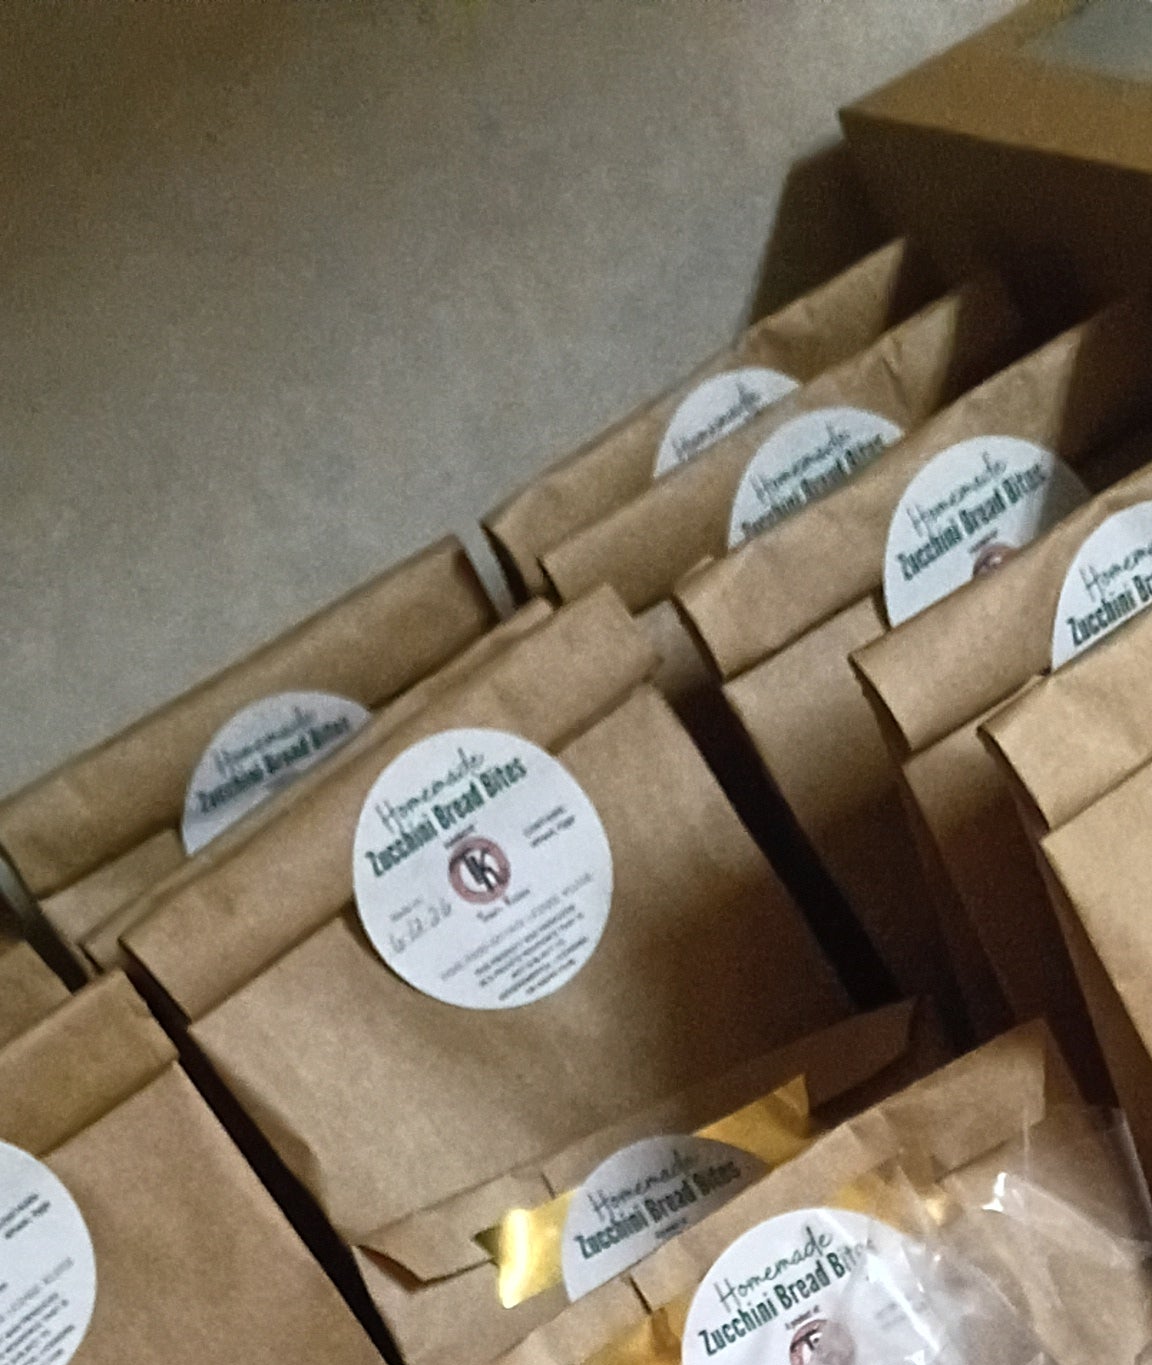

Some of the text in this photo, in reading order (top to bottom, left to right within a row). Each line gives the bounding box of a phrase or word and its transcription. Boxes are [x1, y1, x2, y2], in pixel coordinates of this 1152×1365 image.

[698, 1292, 778, 1358] Zucchini
[773, 1259, 831, 1310] Bread
[713, 1226, 833, 1313] Homemade
